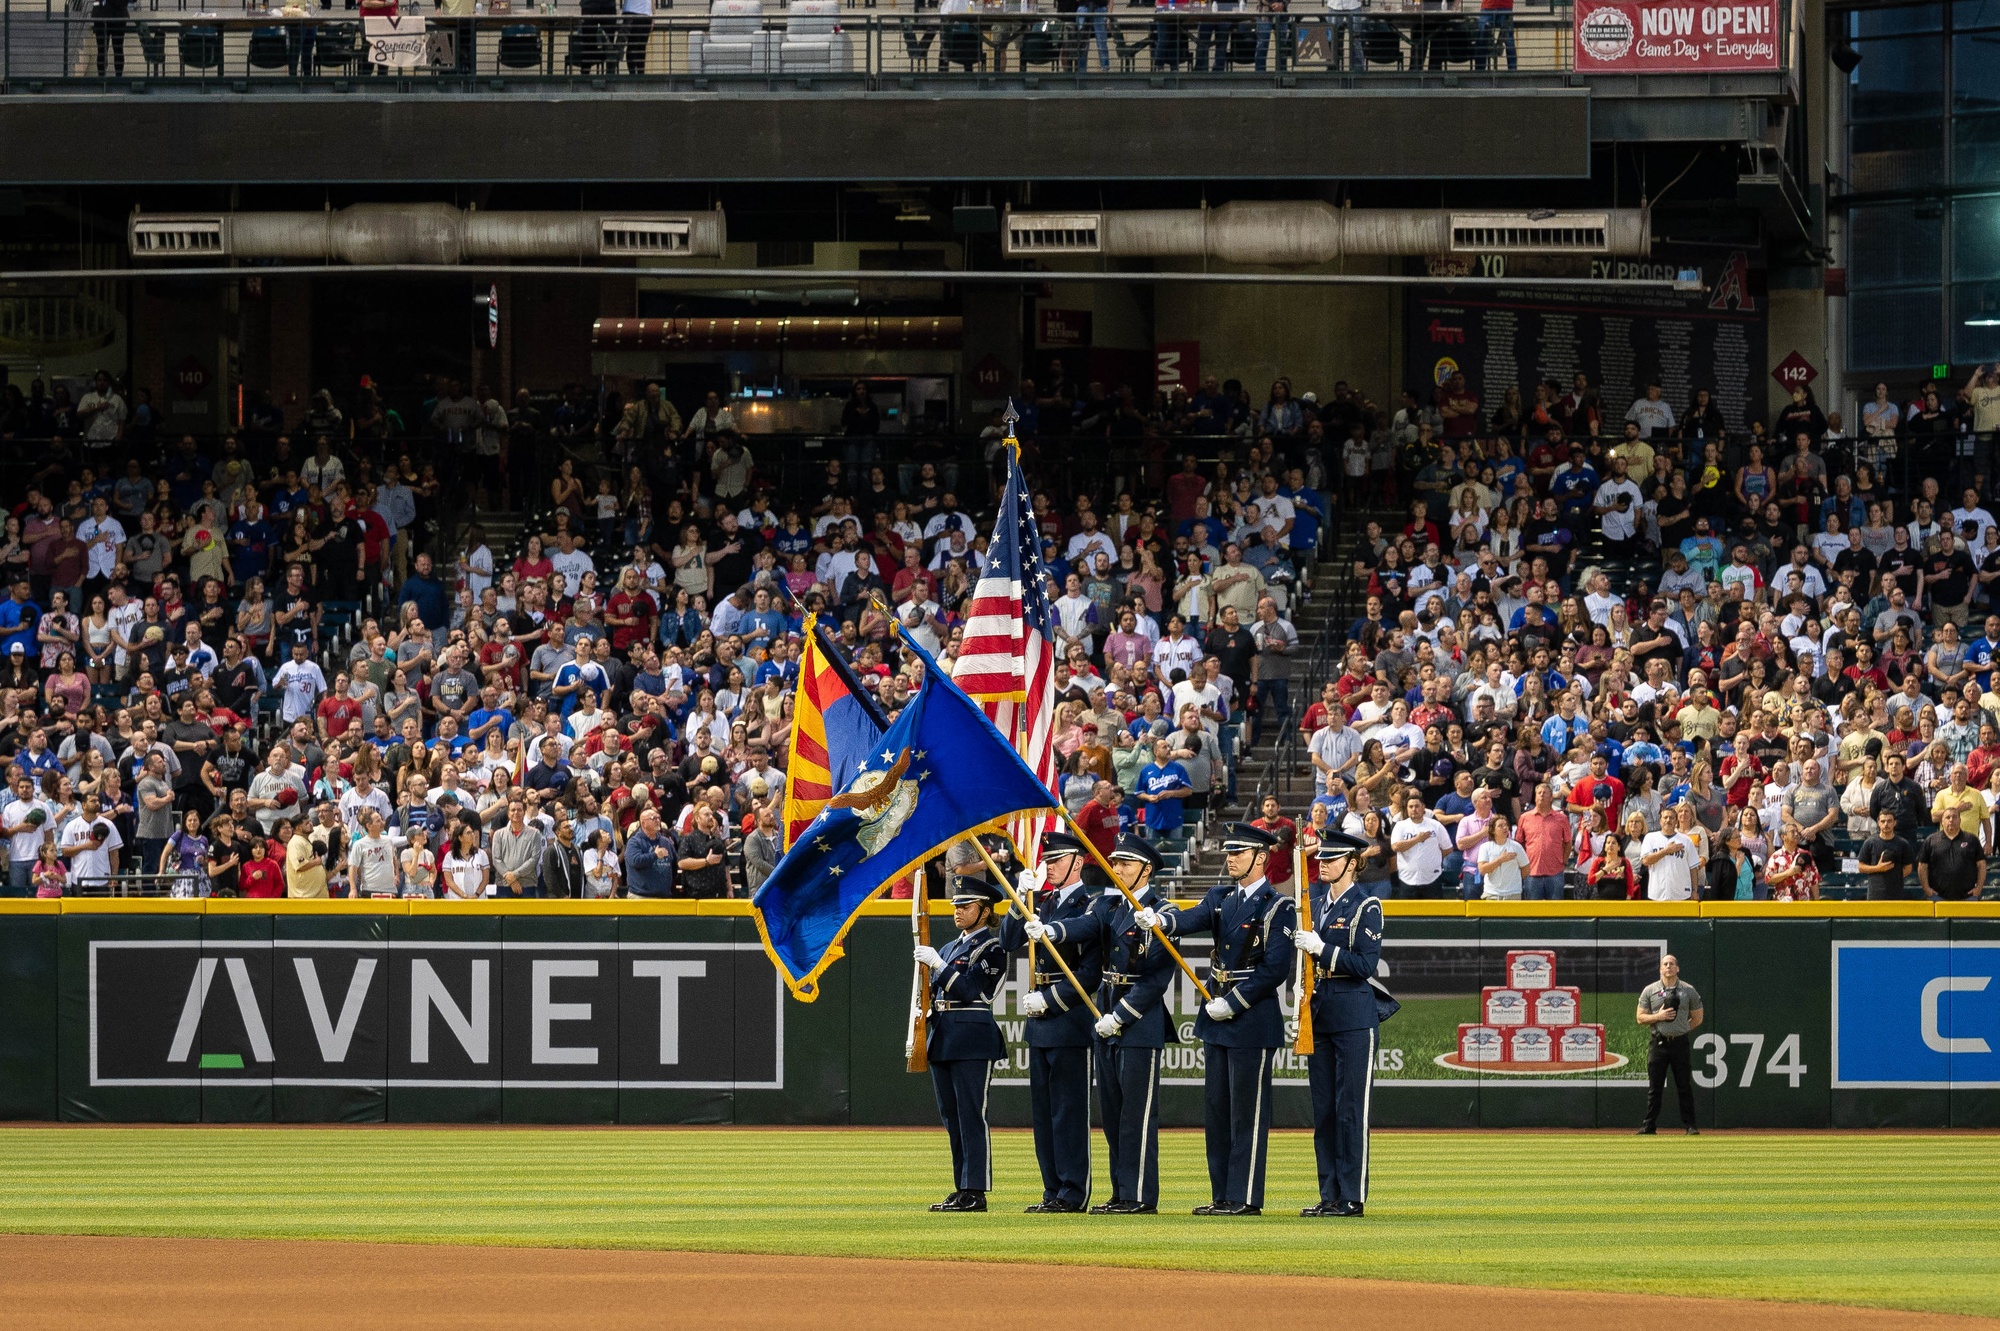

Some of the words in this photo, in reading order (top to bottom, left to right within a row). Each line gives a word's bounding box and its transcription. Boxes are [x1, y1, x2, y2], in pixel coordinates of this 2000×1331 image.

[1642, 7, 1695, 36] NOW
[1701, 6, 1770, 36] OPEN!
[1636, 39, 1671, 58] Game
[1673, 38, 1700, 61] Day
[1716, 38, 1774, 60] Everyday
[178, 371, 203, 385] 140
[978, 369, 1000, 384] 141
[1782, 367, 1808, 381] 142
[1933, 364, 1947, 379] EXIT
[300, 682, 312, 694] 30
[1147, 773, 1179, 791] Dodgers
[167, 958, 707, 1068] AVNET
[1692, 1033, 1808, 1088] 374
